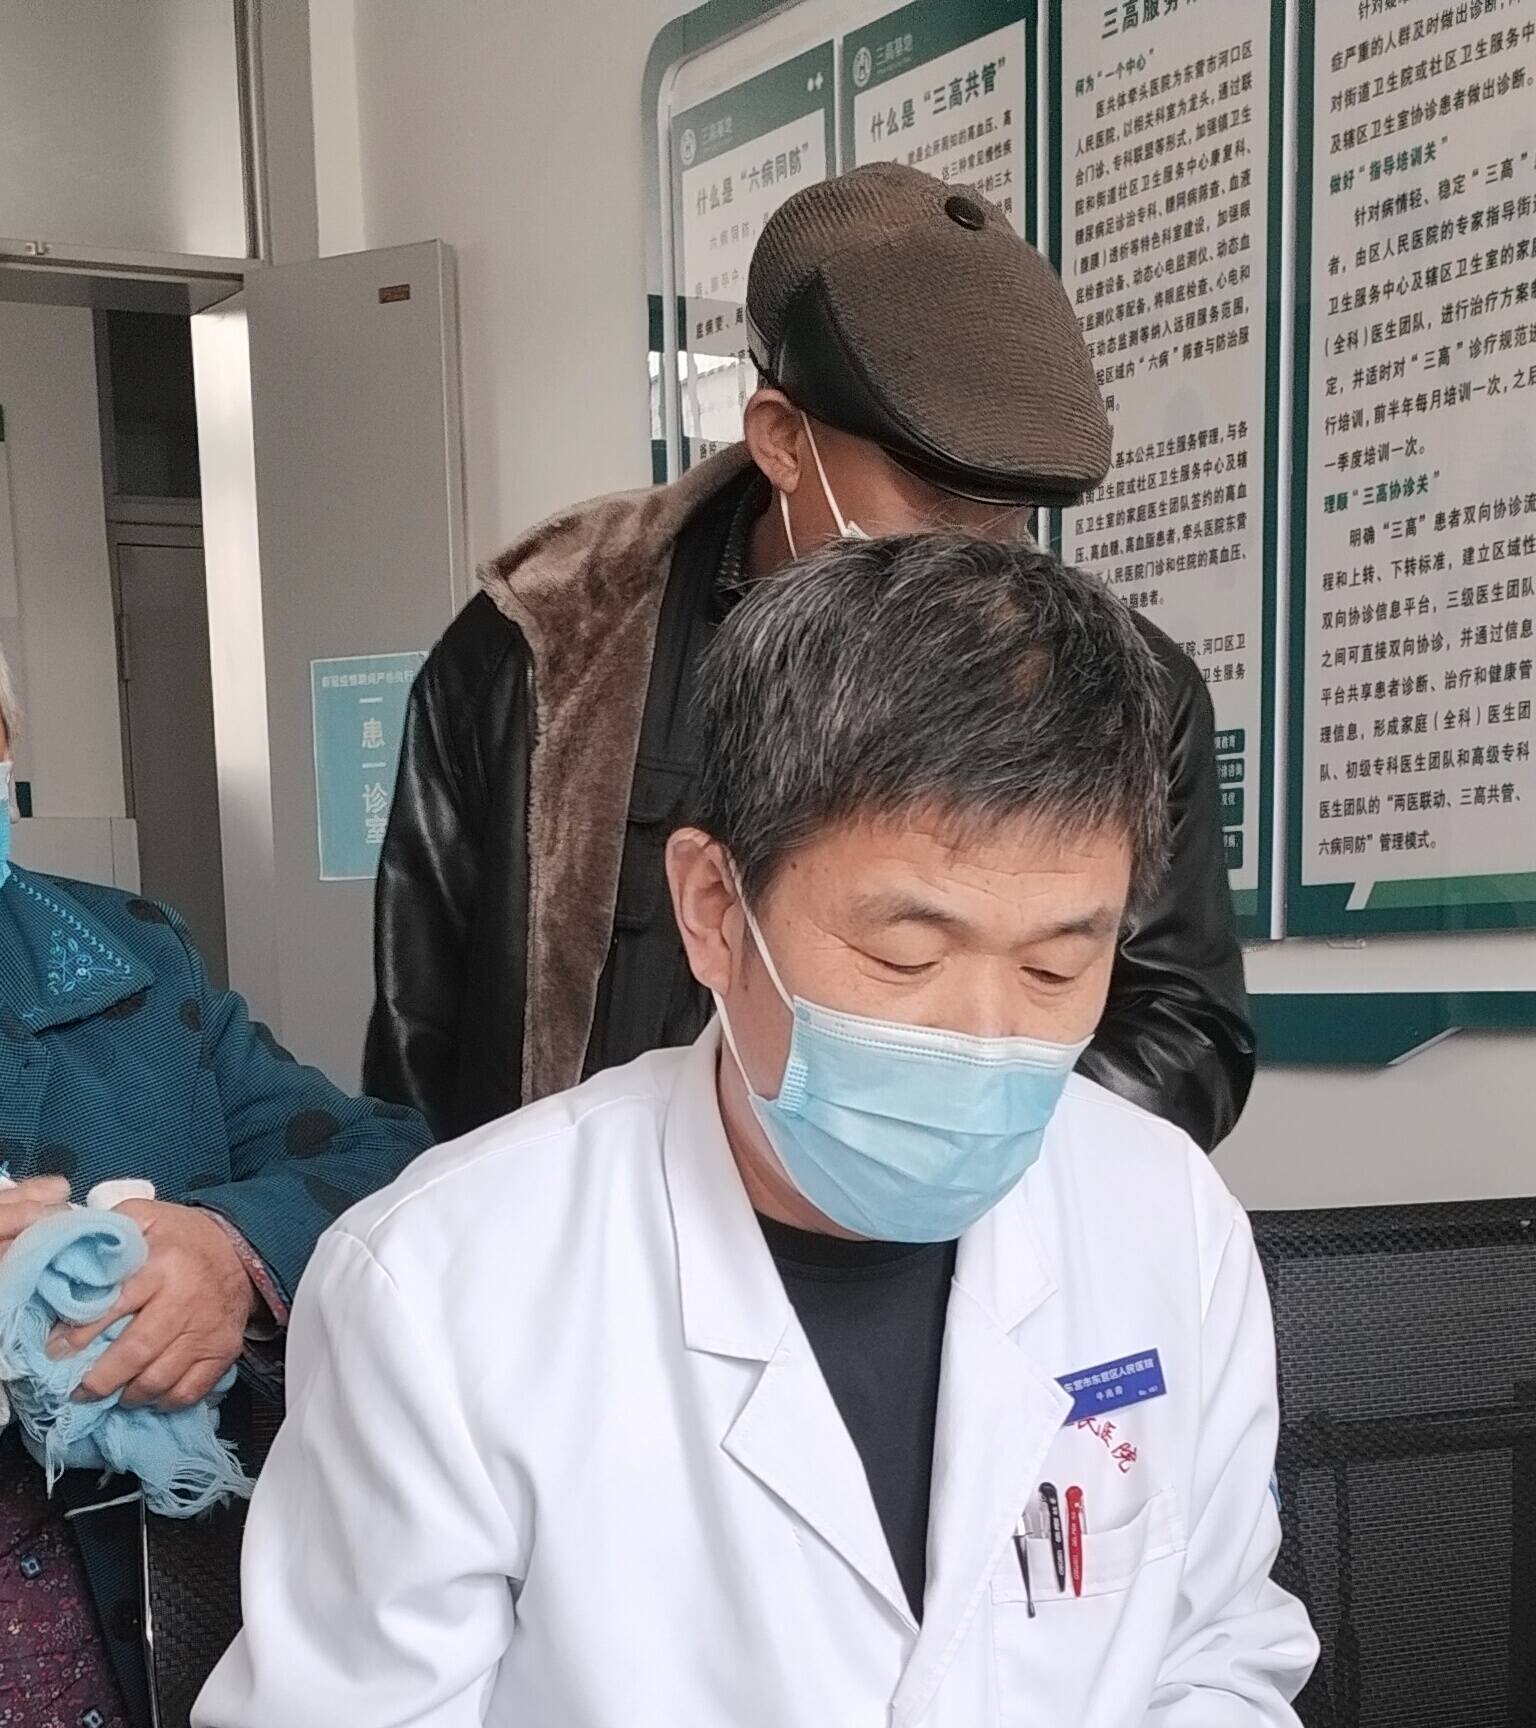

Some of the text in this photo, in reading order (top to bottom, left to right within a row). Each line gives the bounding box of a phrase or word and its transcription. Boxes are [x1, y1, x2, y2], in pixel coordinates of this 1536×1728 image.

[870, 56, 1006, 143] 什么是“三高共管”
[1096, 40, 1253, 119] 医共体牵头医院为东营市河口区
[1330, 66, 1534, 154] 及辖区卫生室协诊患者做出诊断。
[1075, 137, 1252, 217] 院和街道社区卫生服务中心康复科、
[1330, 136, 1448, 195] 做好“指导培训关”
[1324, 436, 1425, 473] 一季度培训一次。
[1075, 482, 1247, 536] 区卫生室的家庭医生团队签约的高血
[1323, 470, 1440, 514] 理顺“三高协诊关”
[1322, 533, 1536, 592] 程和上转、下转标准，建立区域性
[1321, 576, 1535, 630] 双向协诊信息平台，三级医生团队
[1321, 618, 1534, 668] 之间可直接双向协诊，并通过信息
[1321, 658, 1533, 706] 平台共享患者诊断、治疗和健康管
[1320, 700, 1531, 744] 理信息，形成家庭（全科）医生团
[1320, 740, 1530, 782] 队、初级专科医生团队和高级专科
[1319, 782, 1522, 819] 医生团队的“两医联动、三高共管、
[1318, 830, 1437, 856] 六病同防”管理模式。
